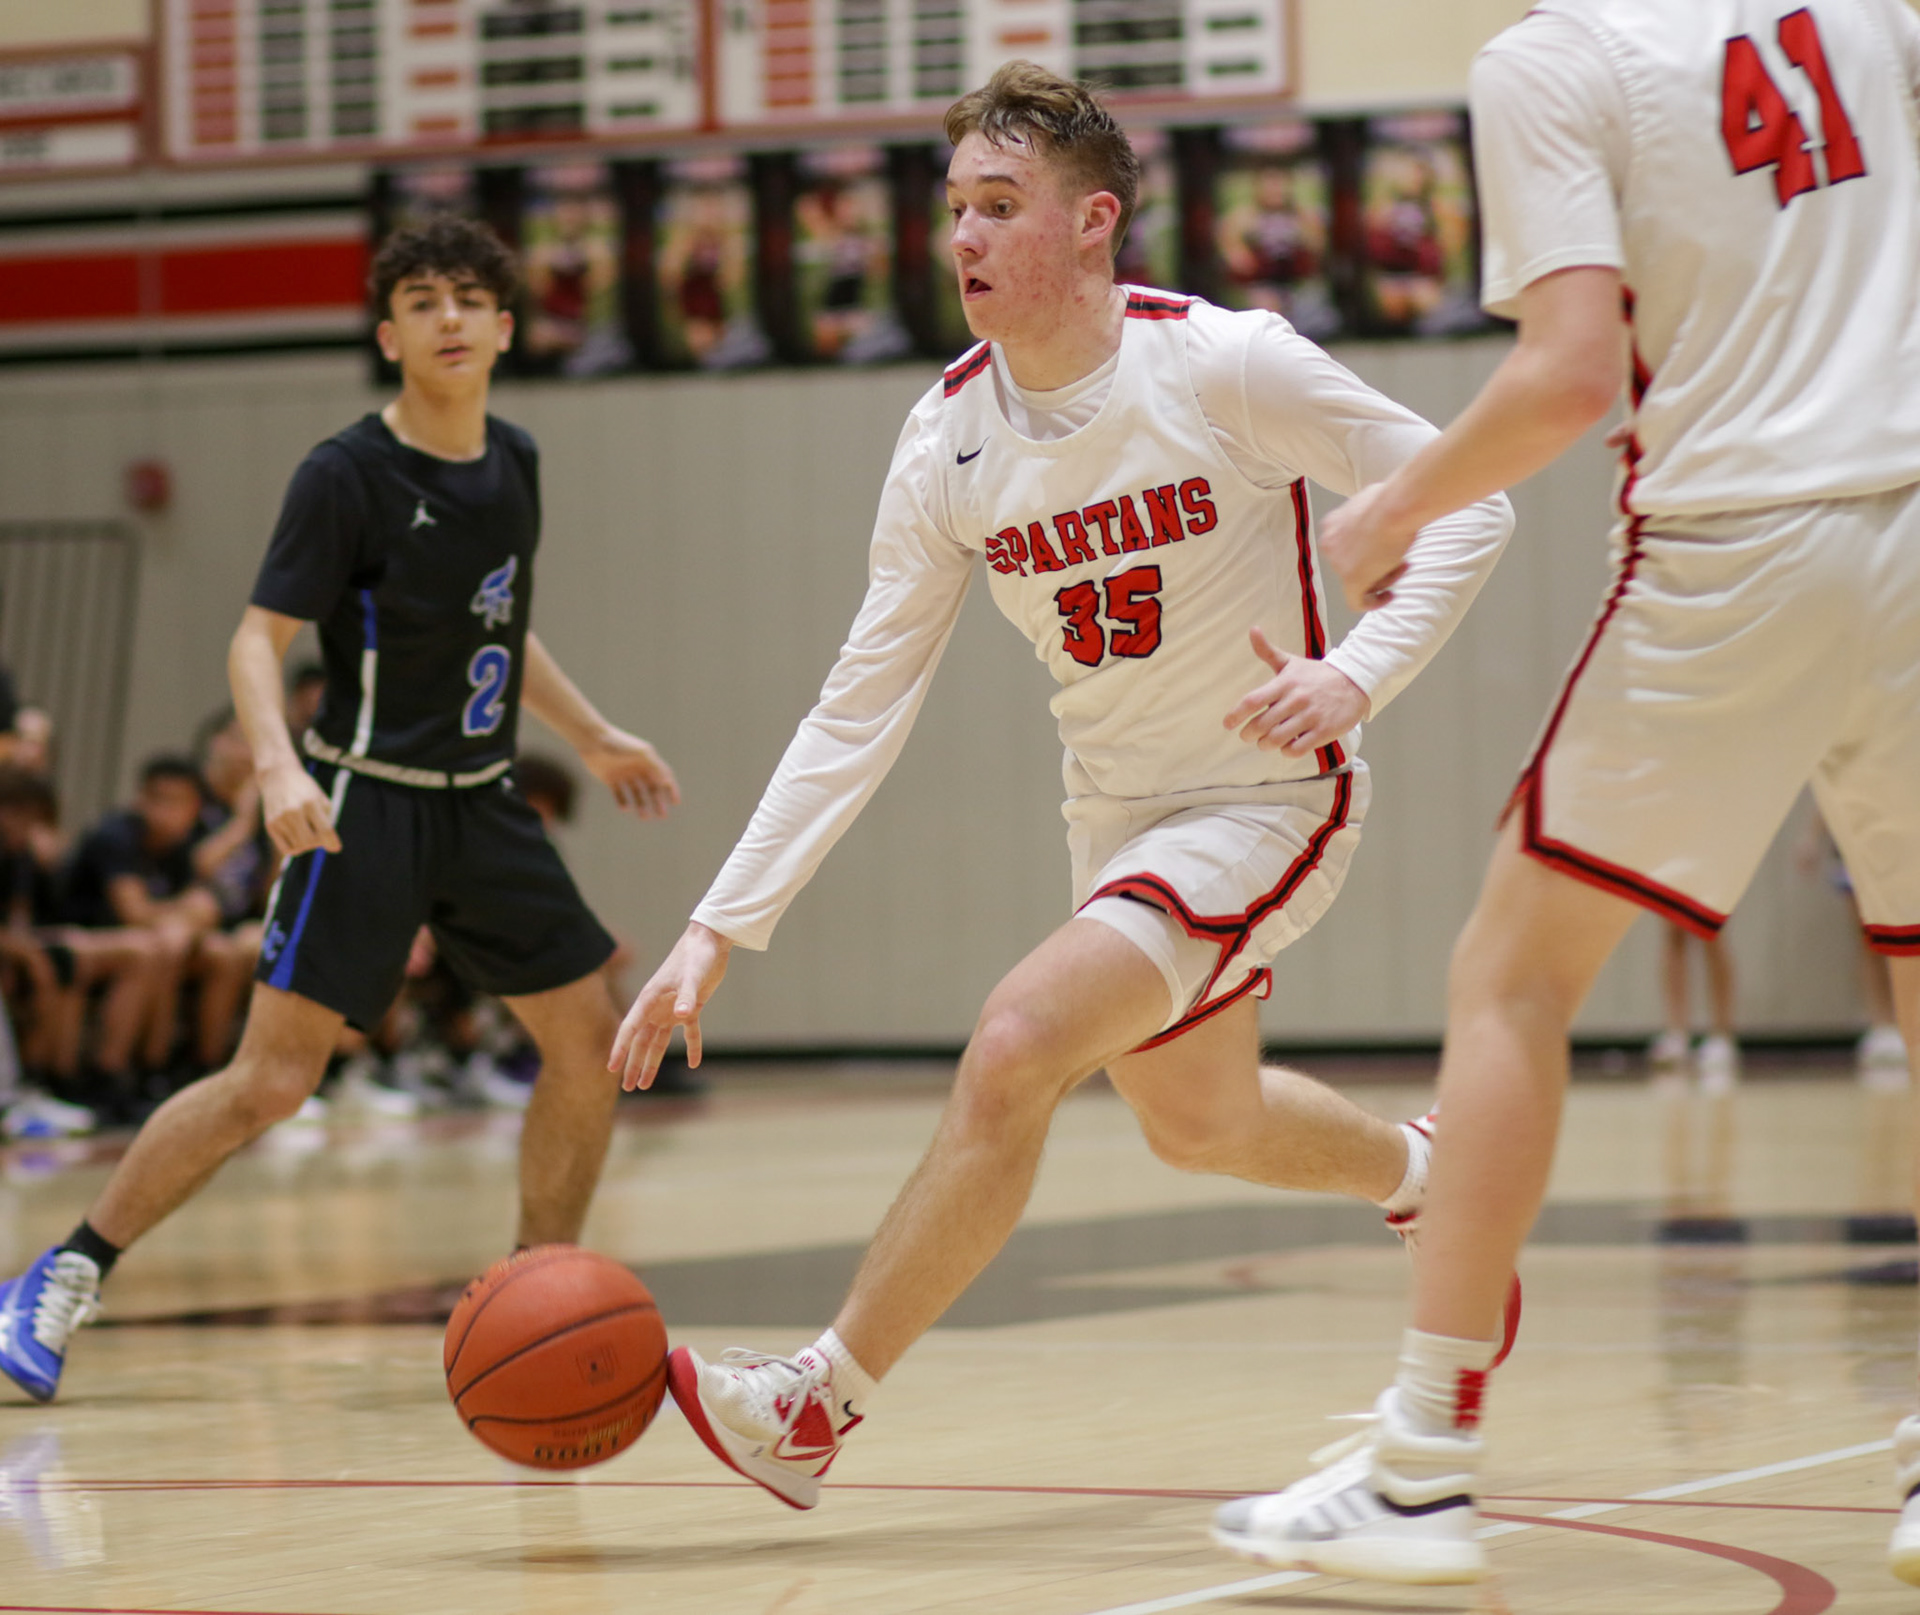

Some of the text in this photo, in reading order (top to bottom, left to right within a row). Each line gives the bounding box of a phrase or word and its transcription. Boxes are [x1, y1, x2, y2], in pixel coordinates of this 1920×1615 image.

[1721, 7, 1868, 208] 41
[985, 477, 1218, 577] SPARTANS
[1054, 565, 1162, 667] 35
[463, 645, 511, 736] 2
